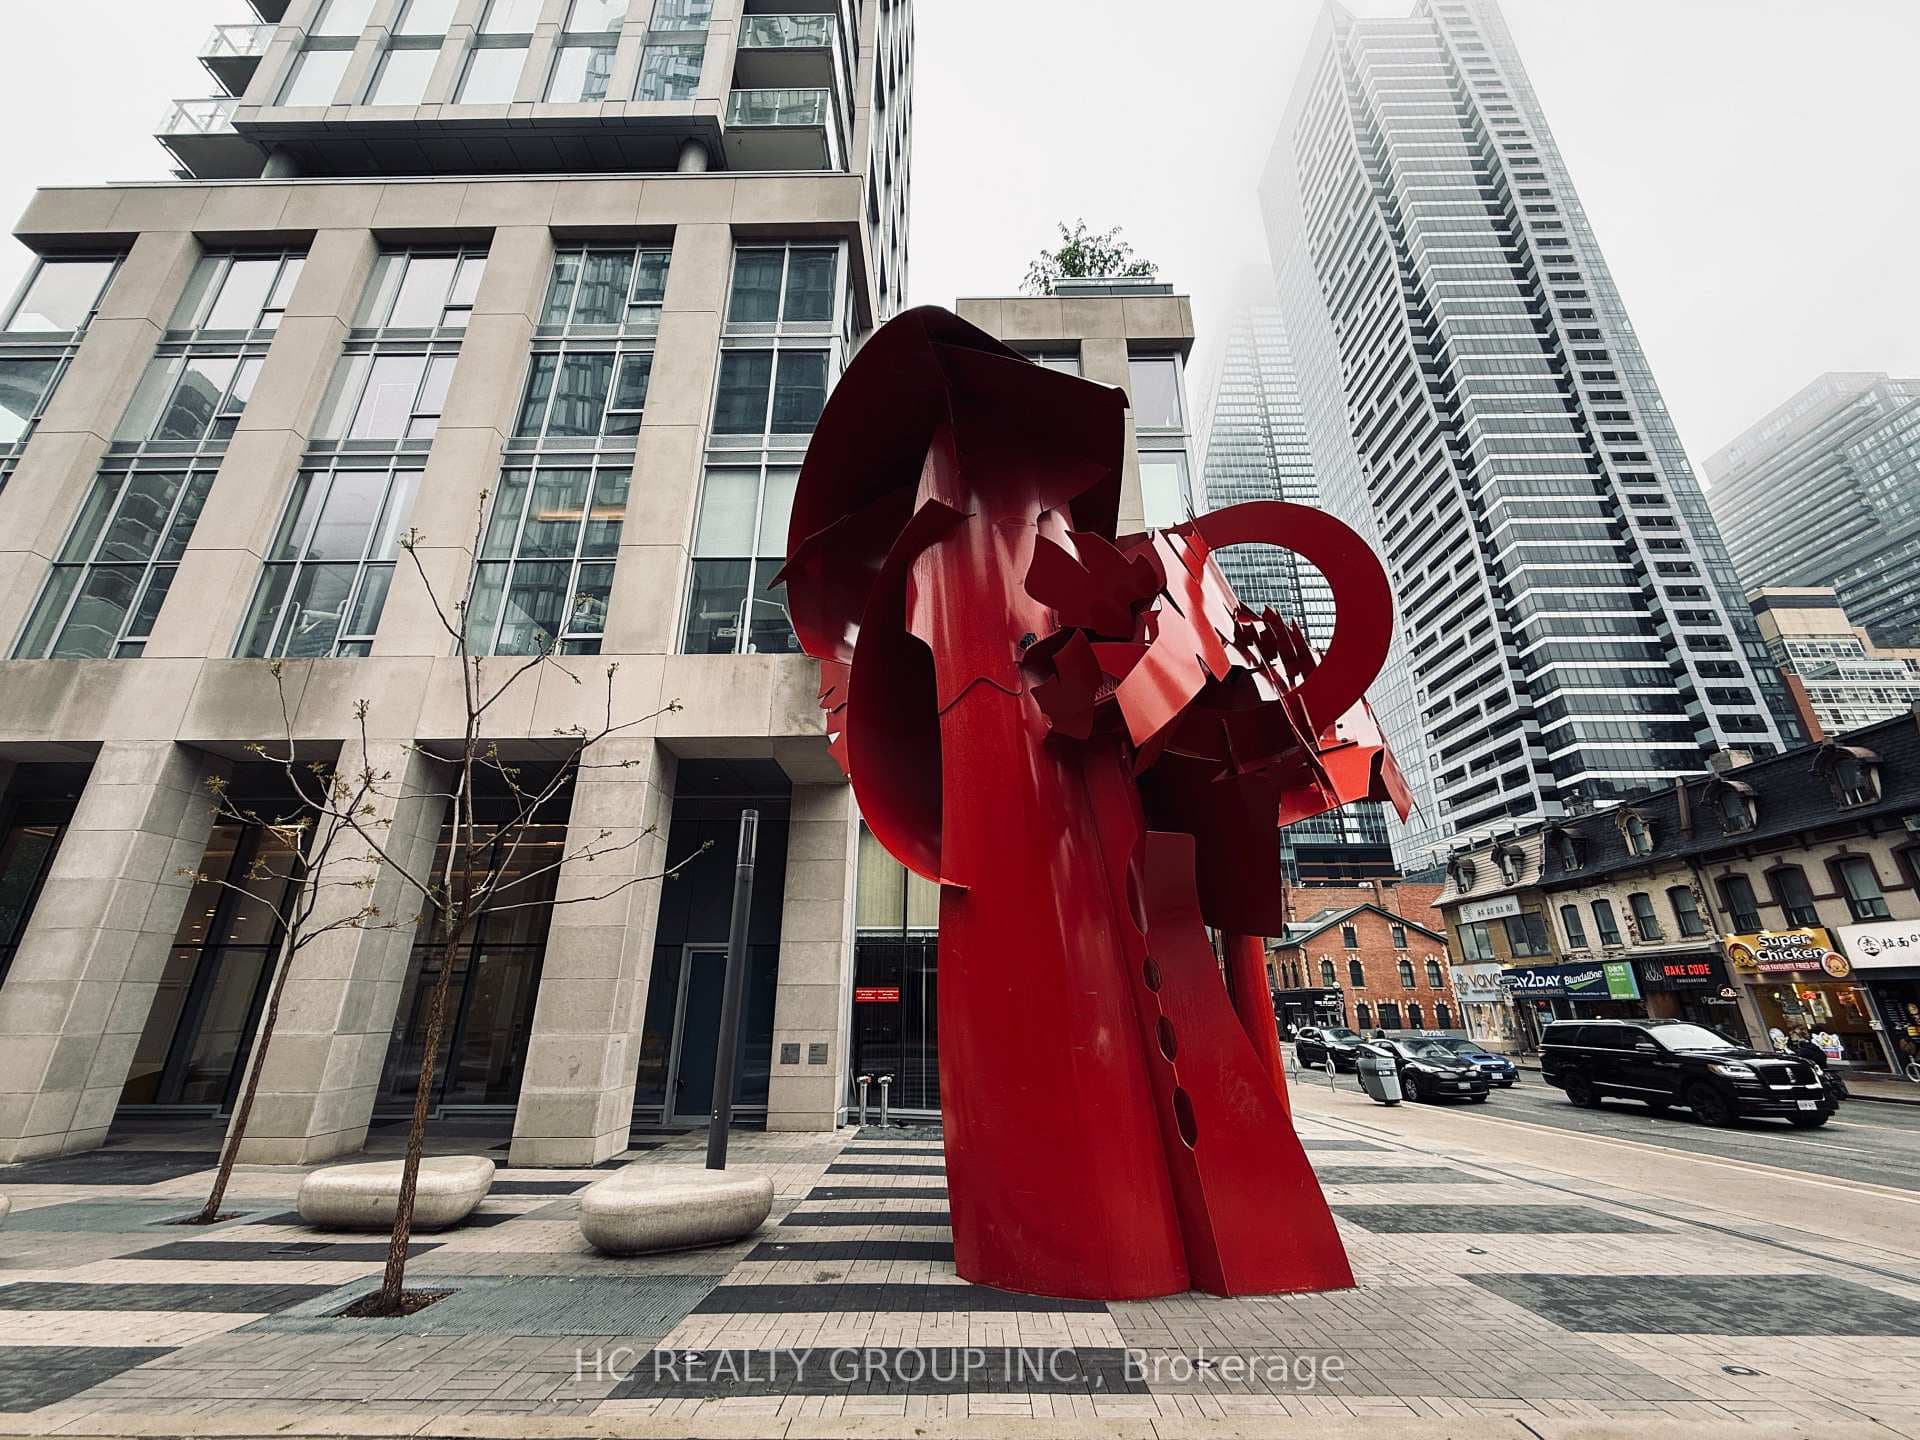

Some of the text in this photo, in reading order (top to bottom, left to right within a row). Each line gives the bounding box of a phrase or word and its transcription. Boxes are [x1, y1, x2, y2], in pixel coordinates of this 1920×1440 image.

[1758, 935, 1809, 947] Super
[1757, 948, 1824, 961] Chicken
[1664, 964, 1712, 976] BAKE CODE
